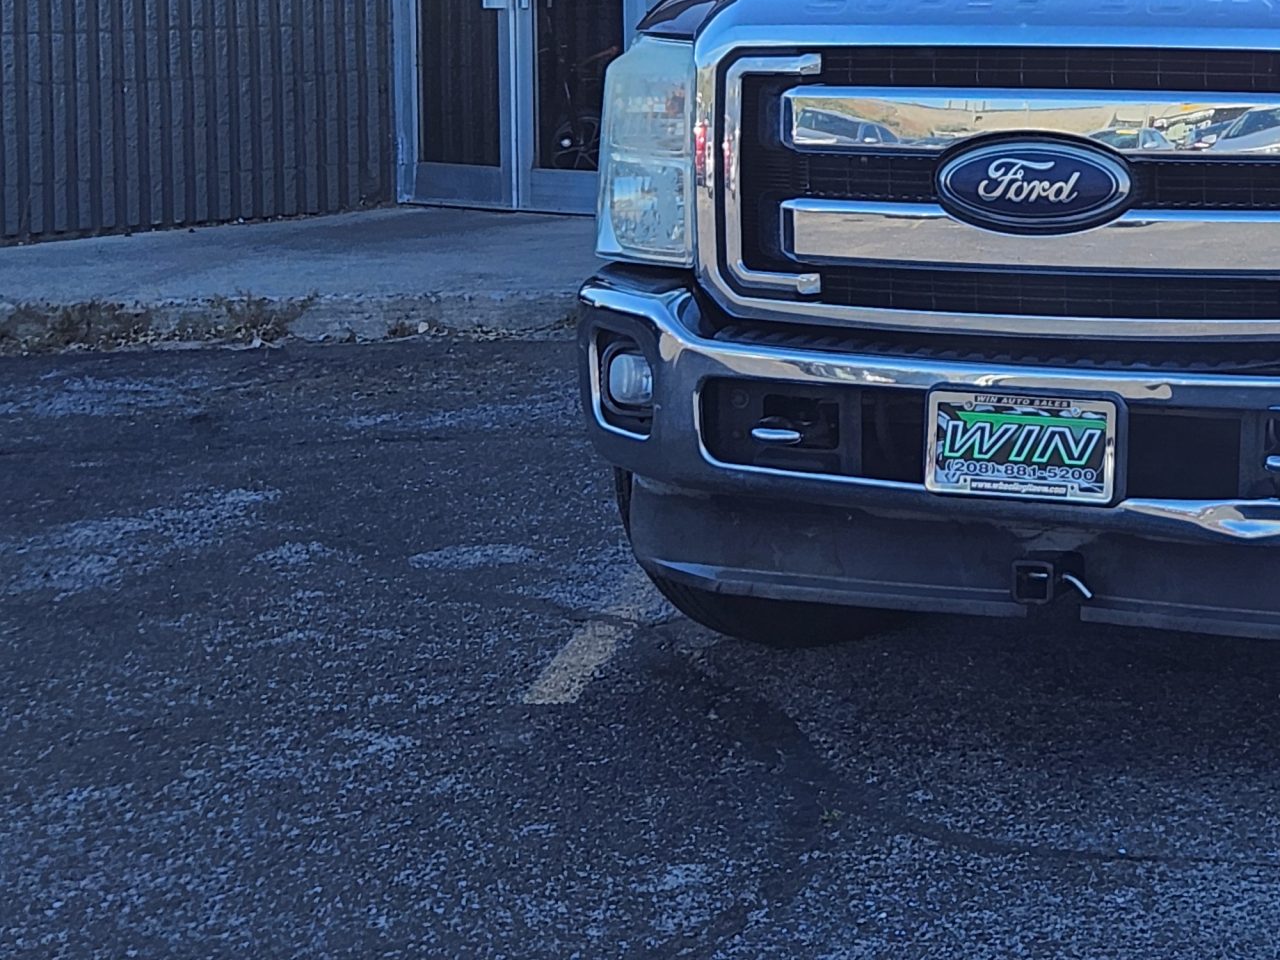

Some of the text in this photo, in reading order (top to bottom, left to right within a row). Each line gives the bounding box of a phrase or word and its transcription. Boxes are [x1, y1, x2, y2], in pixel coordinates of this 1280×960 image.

[977, 157, 1081, 204] Ford
[976, 395, 1069, 409] WIN AUTO SALES
[944, 420, 1102, 465] WIN
